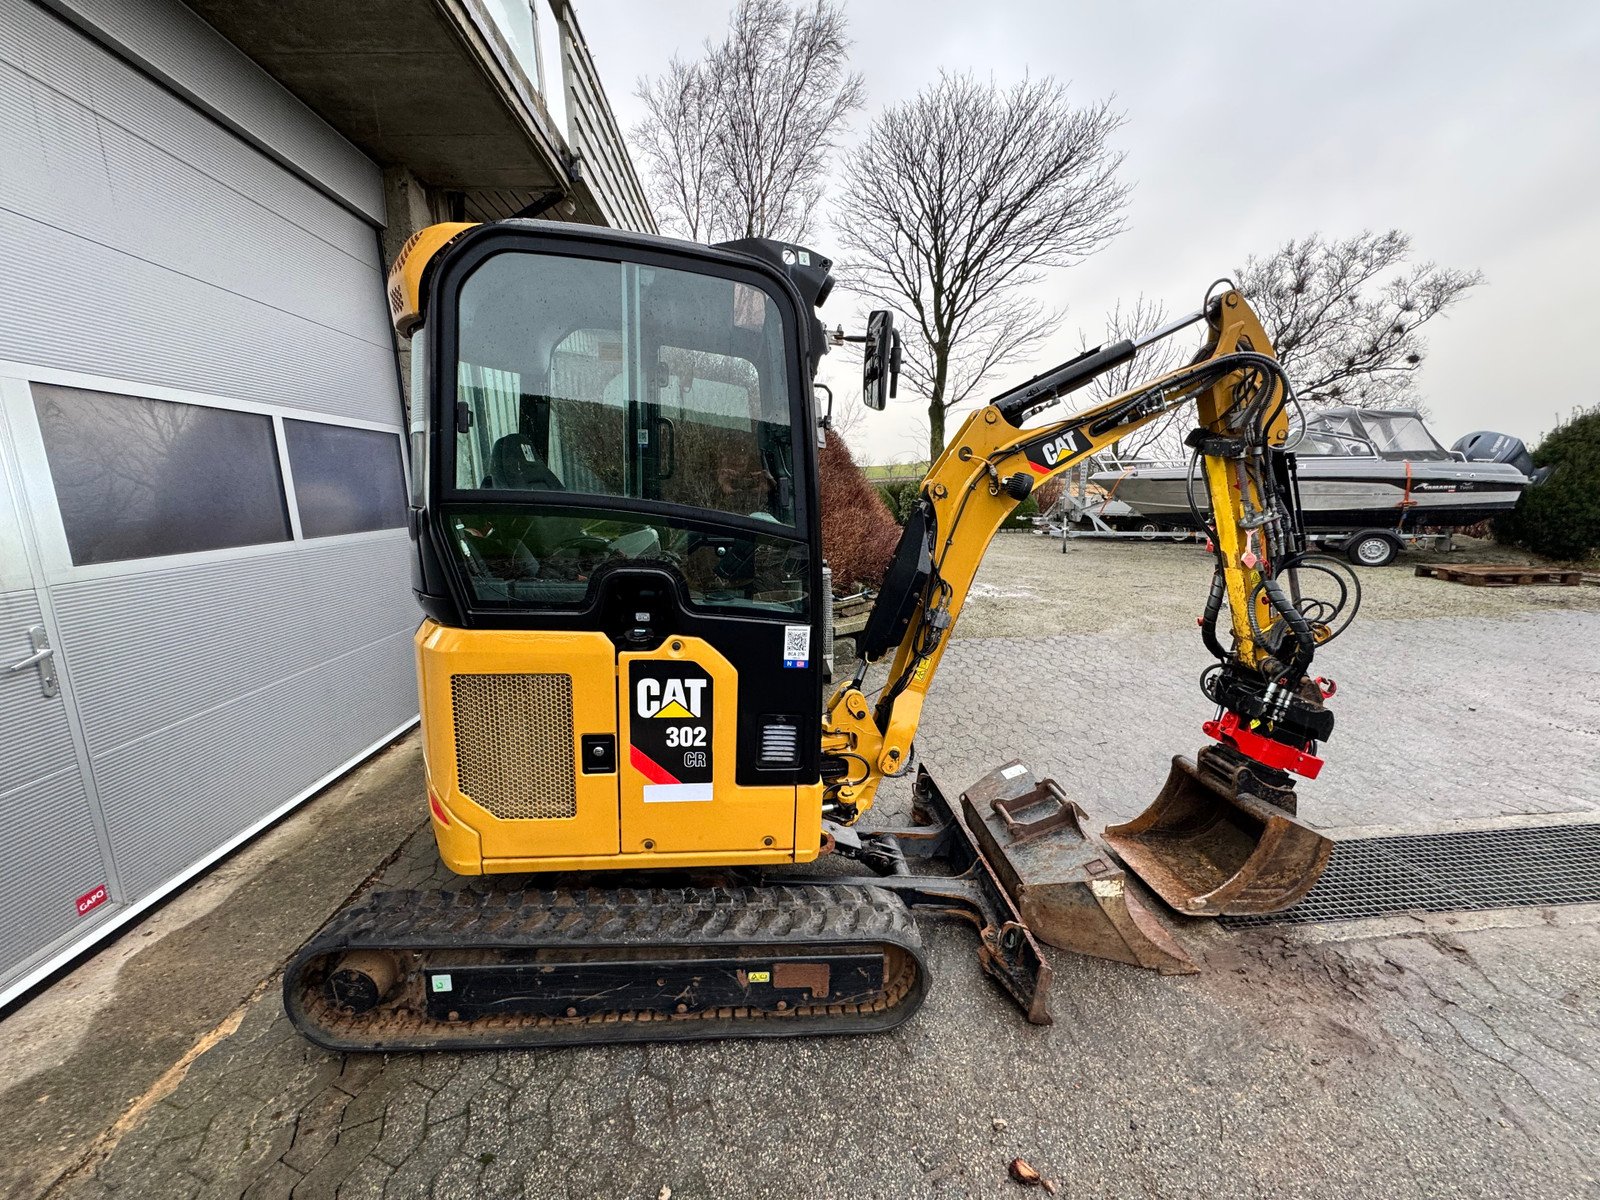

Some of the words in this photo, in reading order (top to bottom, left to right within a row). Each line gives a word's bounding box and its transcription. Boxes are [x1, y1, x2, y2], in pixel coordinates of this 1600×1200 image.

[1042, 430, 1078, 465] CAT
[637, 678, 707, 718] CAT
[666, 726, 707, 747] 302
[684, 751, 706, 767] CR
[79, 889, 104, 911] GAPO
